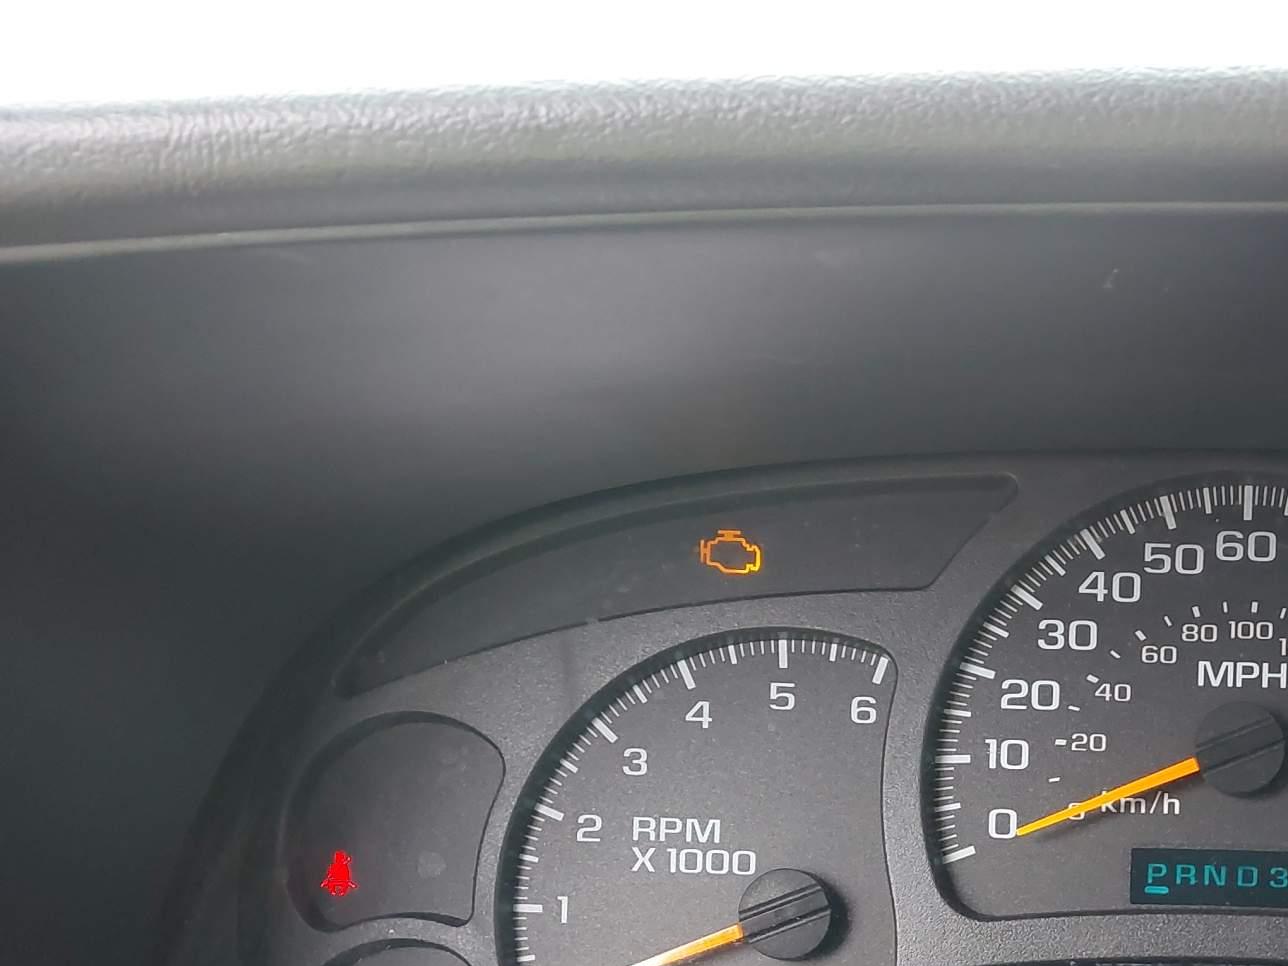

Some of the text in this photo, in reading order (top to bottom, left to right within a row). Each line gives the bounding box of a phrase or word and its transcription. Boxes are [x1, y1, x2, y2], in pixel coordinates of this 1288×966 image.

[1143, 543, 1204, 575] 50
[1216, 531, 1277, 562] 60
[1079, 571, 1141, 603] 40
[1037, 619, 1097, 650] 30
[1181, 624, 1218, 642] 80
[1229, 621, 1273, 641] 100
[1141, 645, 1177, 664] 60
[1197, 661, 1288, 688] MPH
[769, 683, 795, 711] 5
[1000, 680, 1060, 710] 20
[1095, 683, 1132, 702] 40
[685, 701, 713, 728] 4
[850, 696, 877, 725] 6
[984, 739, 1029, 769] 10
[1071, 733, 1107, 752] 20
[623, 748, 649, 775] 3
[1101, 791, 1181, 815] km/h
[576, 815, 603, 842] 2
[631, 818, 722, 844] RPM
[988, 809, 1018, 839] 0
[631, 850, 756, 875] X 1000
[558, 897, 569, 923] 1
